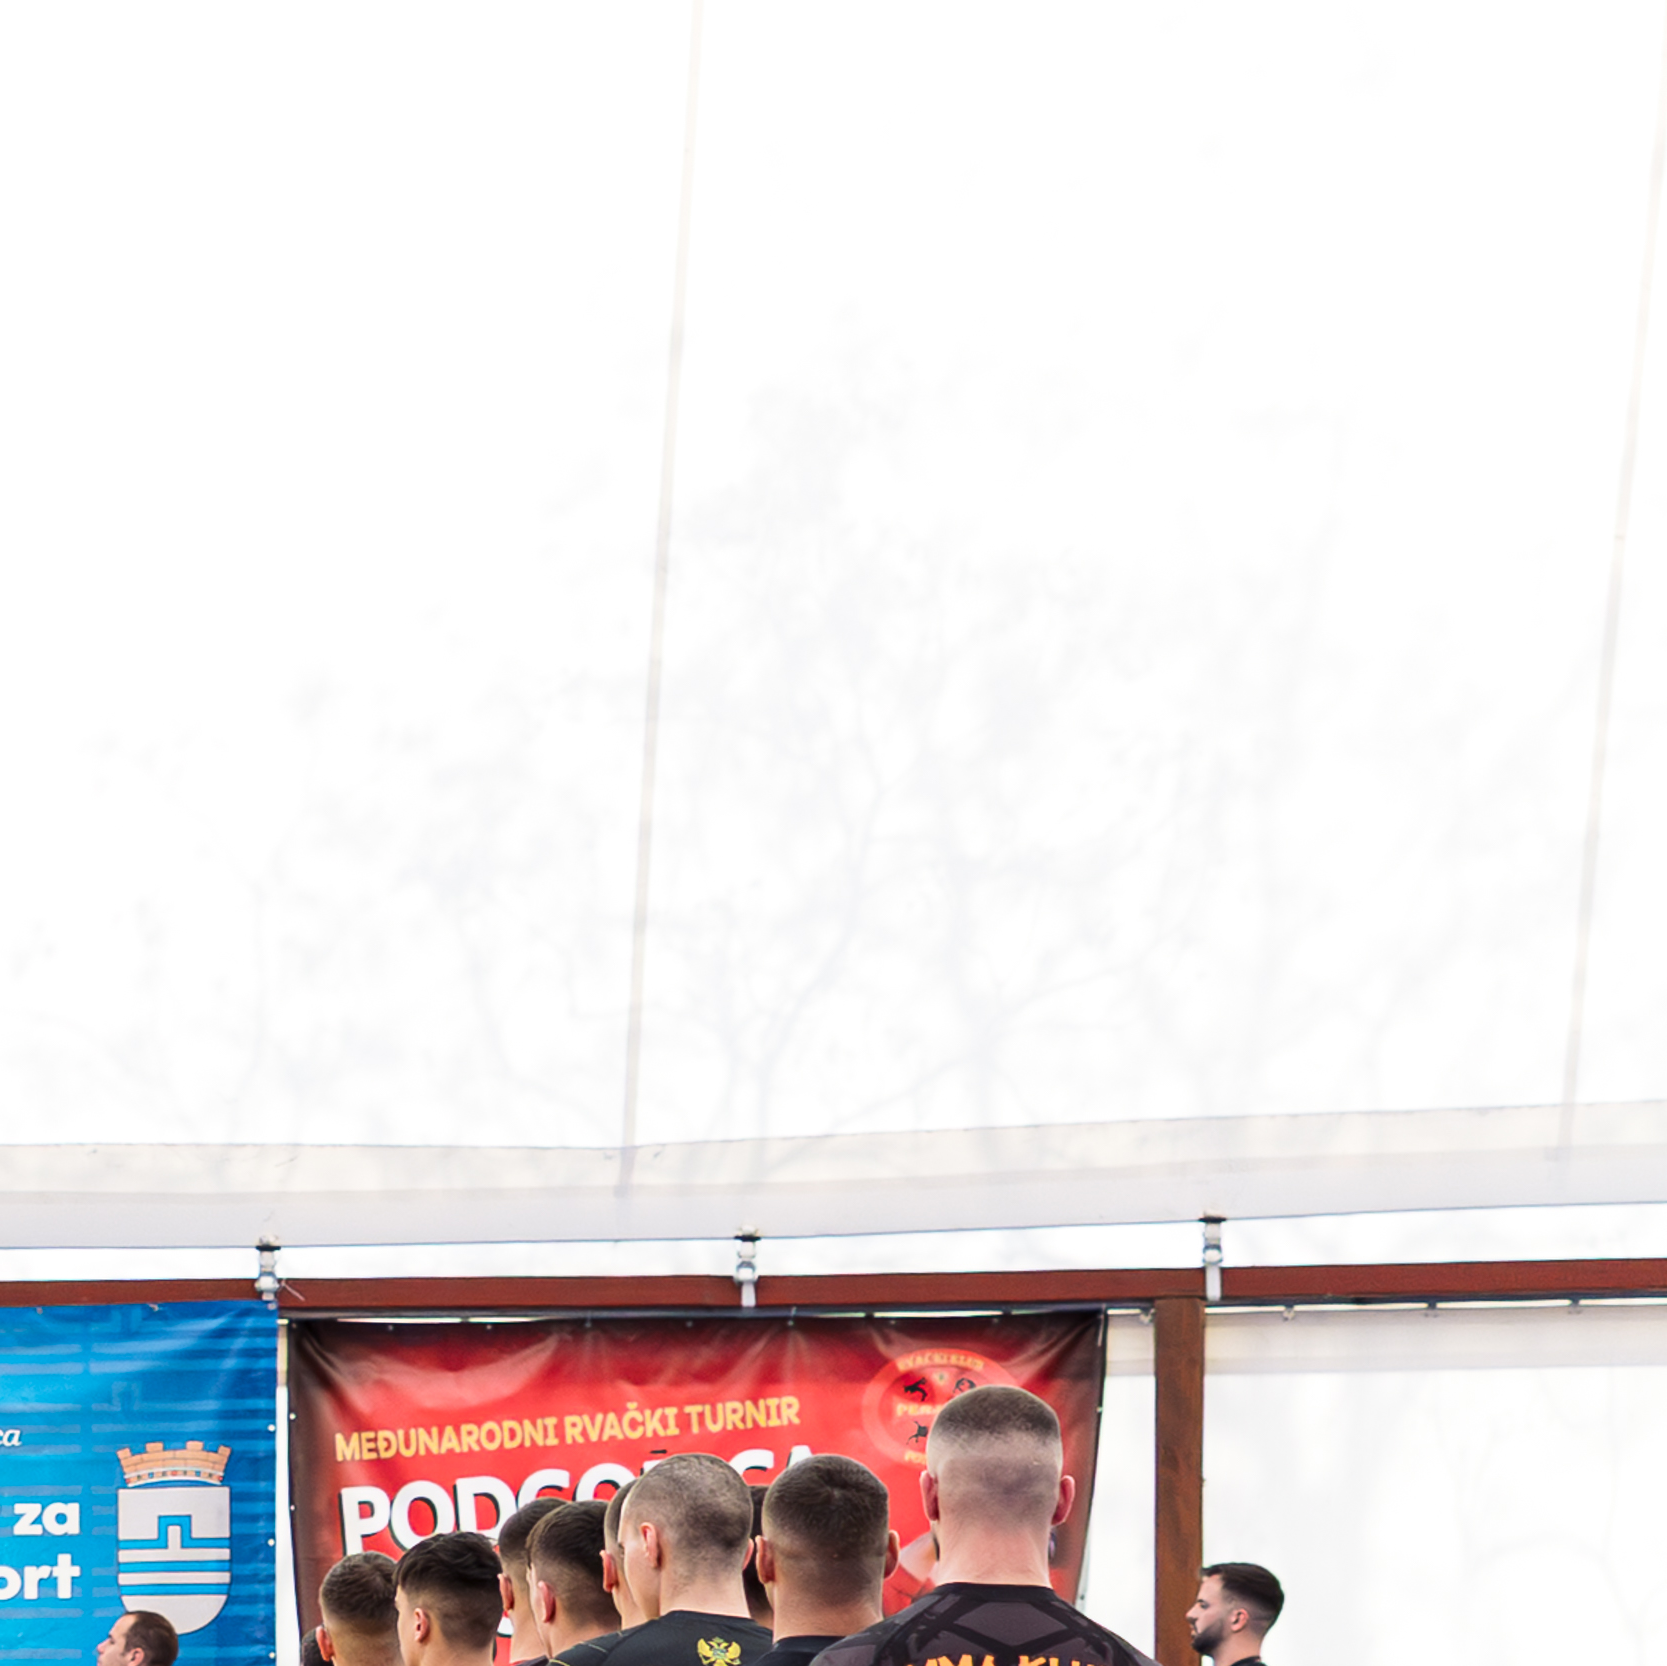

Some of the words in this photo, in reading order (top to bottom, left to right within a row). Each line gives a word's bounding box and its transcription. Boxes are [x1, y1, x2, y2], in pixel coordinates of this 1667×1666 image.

[334, 1416, 558, 1462] MEĐUNARODNI
[564, 1402, 679, 1444] RVAČKI
[684, 1396, 801, 1431] TURNIR
[13, 1502, 81, 1536] za
